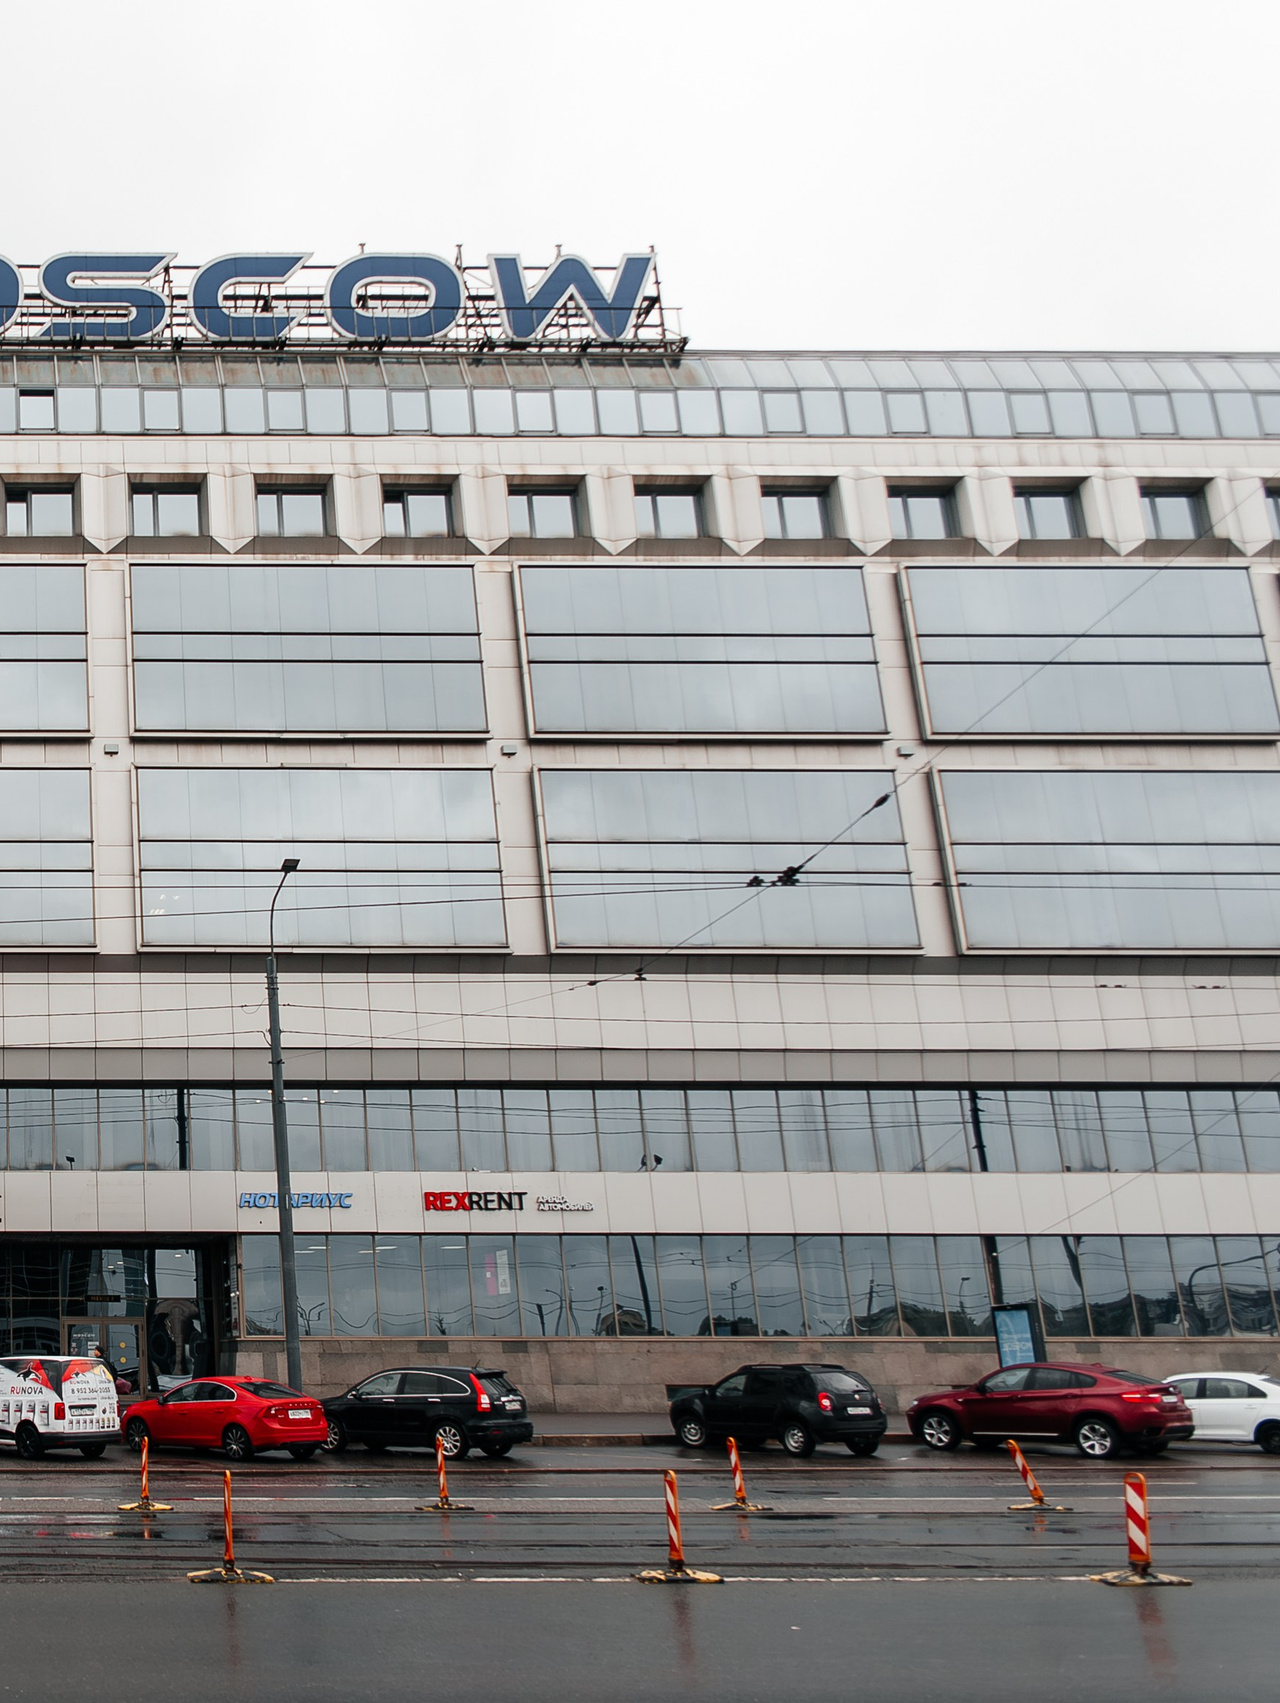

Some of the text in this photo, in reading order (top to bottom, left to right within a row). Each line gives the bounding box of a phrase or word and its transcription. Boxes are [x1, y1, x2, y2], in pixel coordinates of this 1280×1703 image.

[424, 1191, 528, 1211] REXRENT
[538, 1202, 594, 1211] АВТОМОБИЛЕЙ
[10, 1386, 44, 1396] RUNOVA
